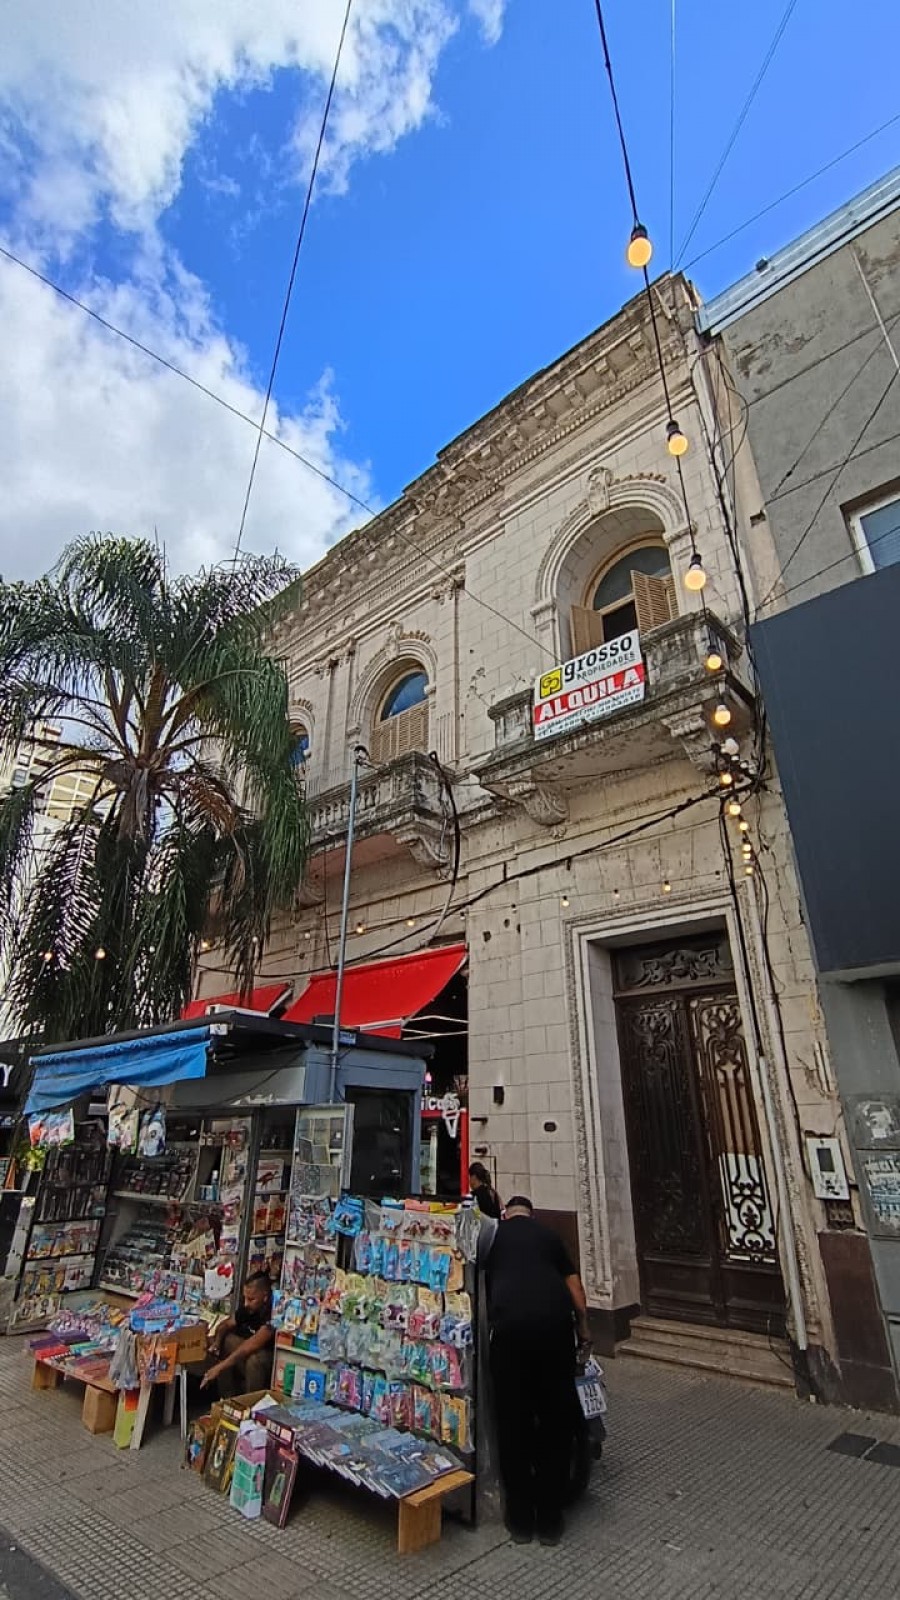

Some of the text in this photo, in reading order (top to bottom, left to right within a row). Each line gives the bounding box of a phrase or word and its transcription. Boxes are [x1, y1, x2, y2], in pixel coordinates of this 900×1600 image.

[566, 636, 632, 682] grosso
[578, 652, 635, 680] PROPIEDADES
[539, 669, 641, 721] ALQUILA
